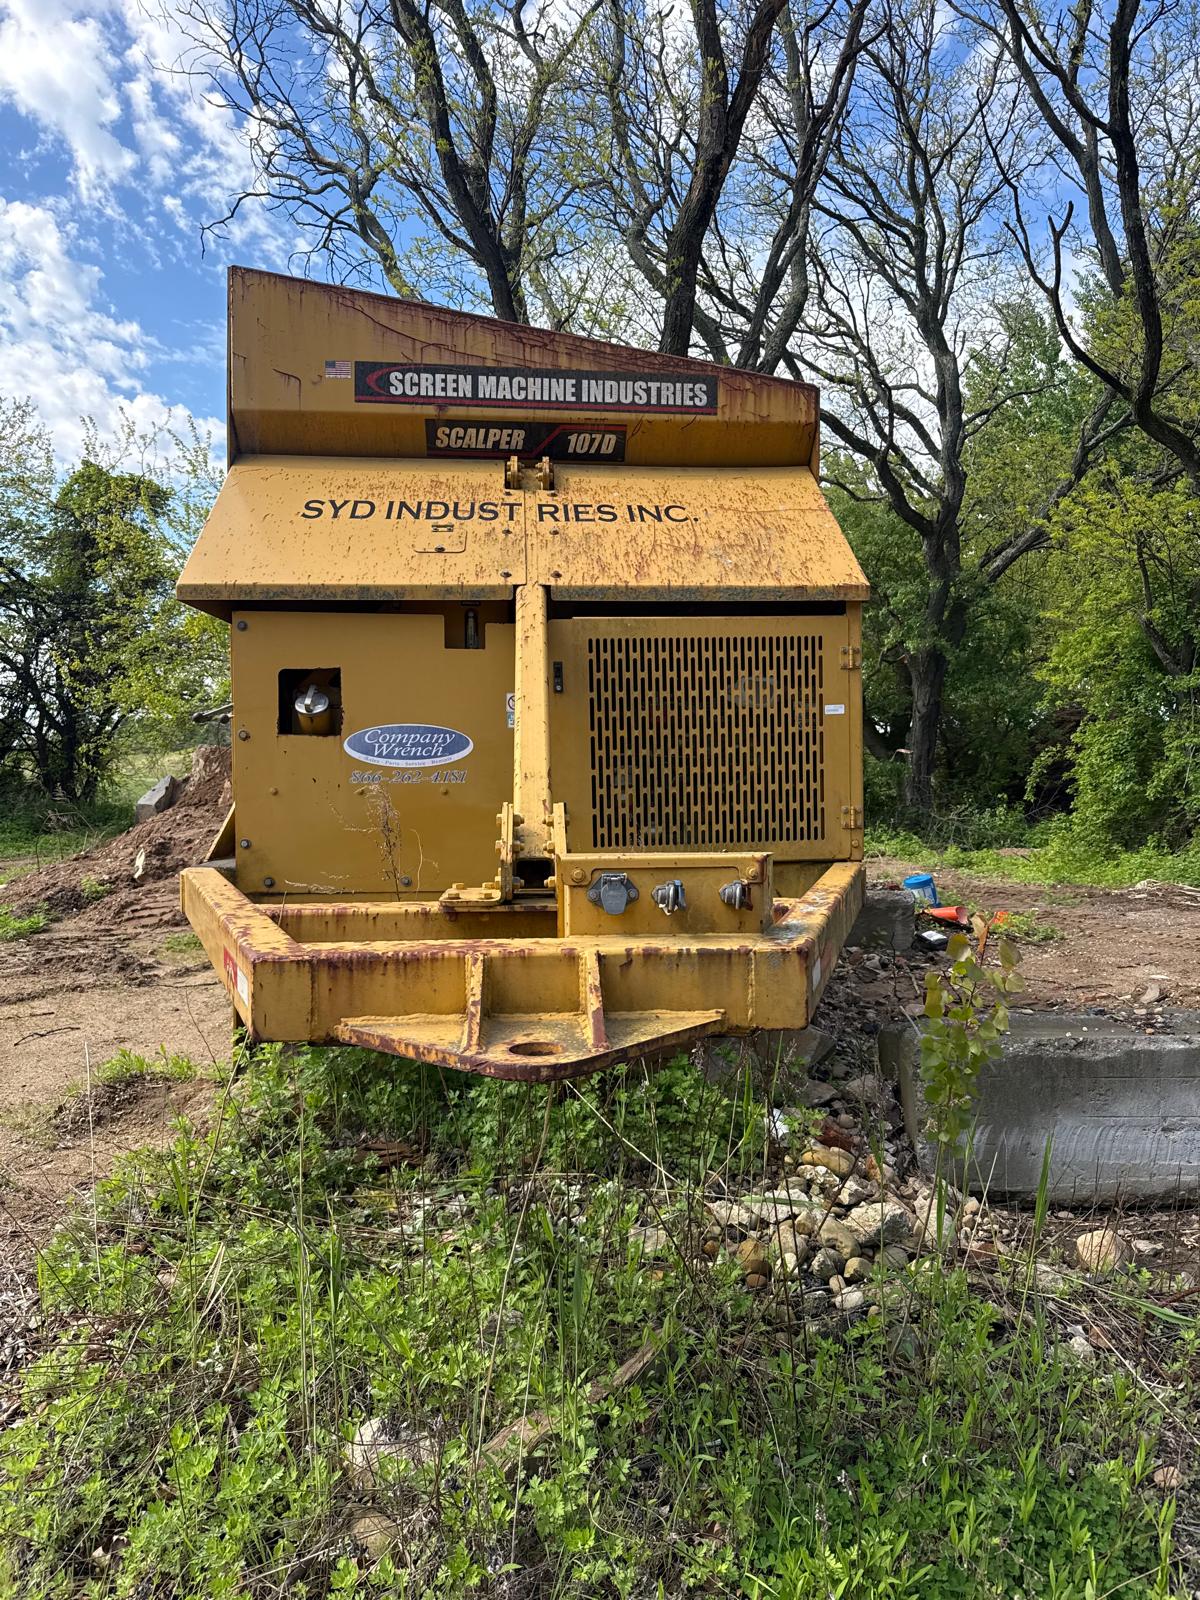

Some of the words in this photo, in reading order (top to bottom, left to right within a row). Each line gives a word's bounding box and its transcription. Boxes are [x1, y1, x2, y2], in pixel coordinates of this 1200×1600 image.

[388, 371, 473, 398] SCREEN
[477, 375, 577, 402] MACHINE
[581, 379, 708, 407] INDUSTRIES
[435, 426, 526, 451] SCALPER
[566, 431, 617, 455] 107D
[301, 499, 376, 520] SYD
[627, 504, 700, 523] INC.
[364, 729, 456, 746] Company
[372, 742, 443, 757] Wrench
[350, 769, 468, 784] 866-262-4181
